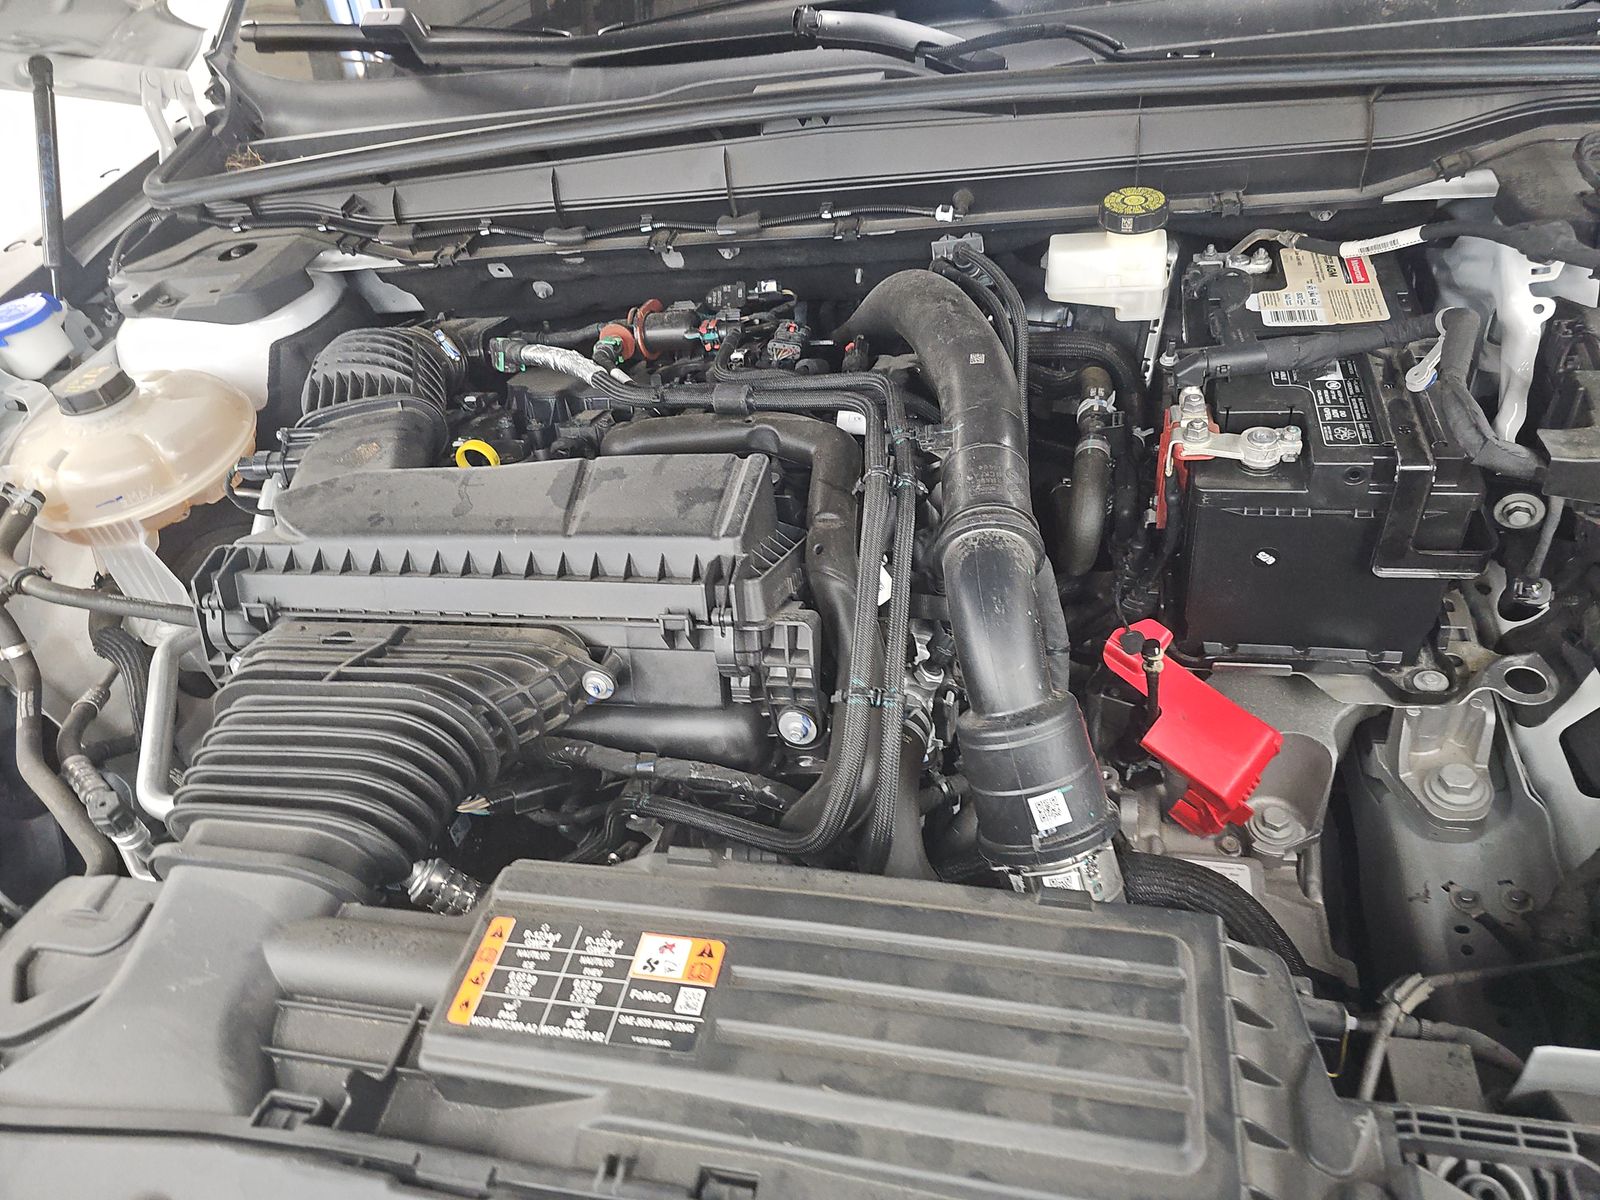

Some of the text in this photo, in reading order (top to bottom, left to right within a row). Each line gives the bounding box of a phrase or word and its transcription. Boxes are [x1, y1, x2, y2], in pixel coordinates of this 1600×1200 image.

[1325, 264, 1338, 278] AGM
[1350, 259, 1365, 282] Motorcraft
[1332, 409, 1340, 418] NOT
[516, 949, 551, 961] NAUTILUS
[579, 955, 615, 968] NAUTILUS
[629, 988, 672, 1004] FoMoCo
